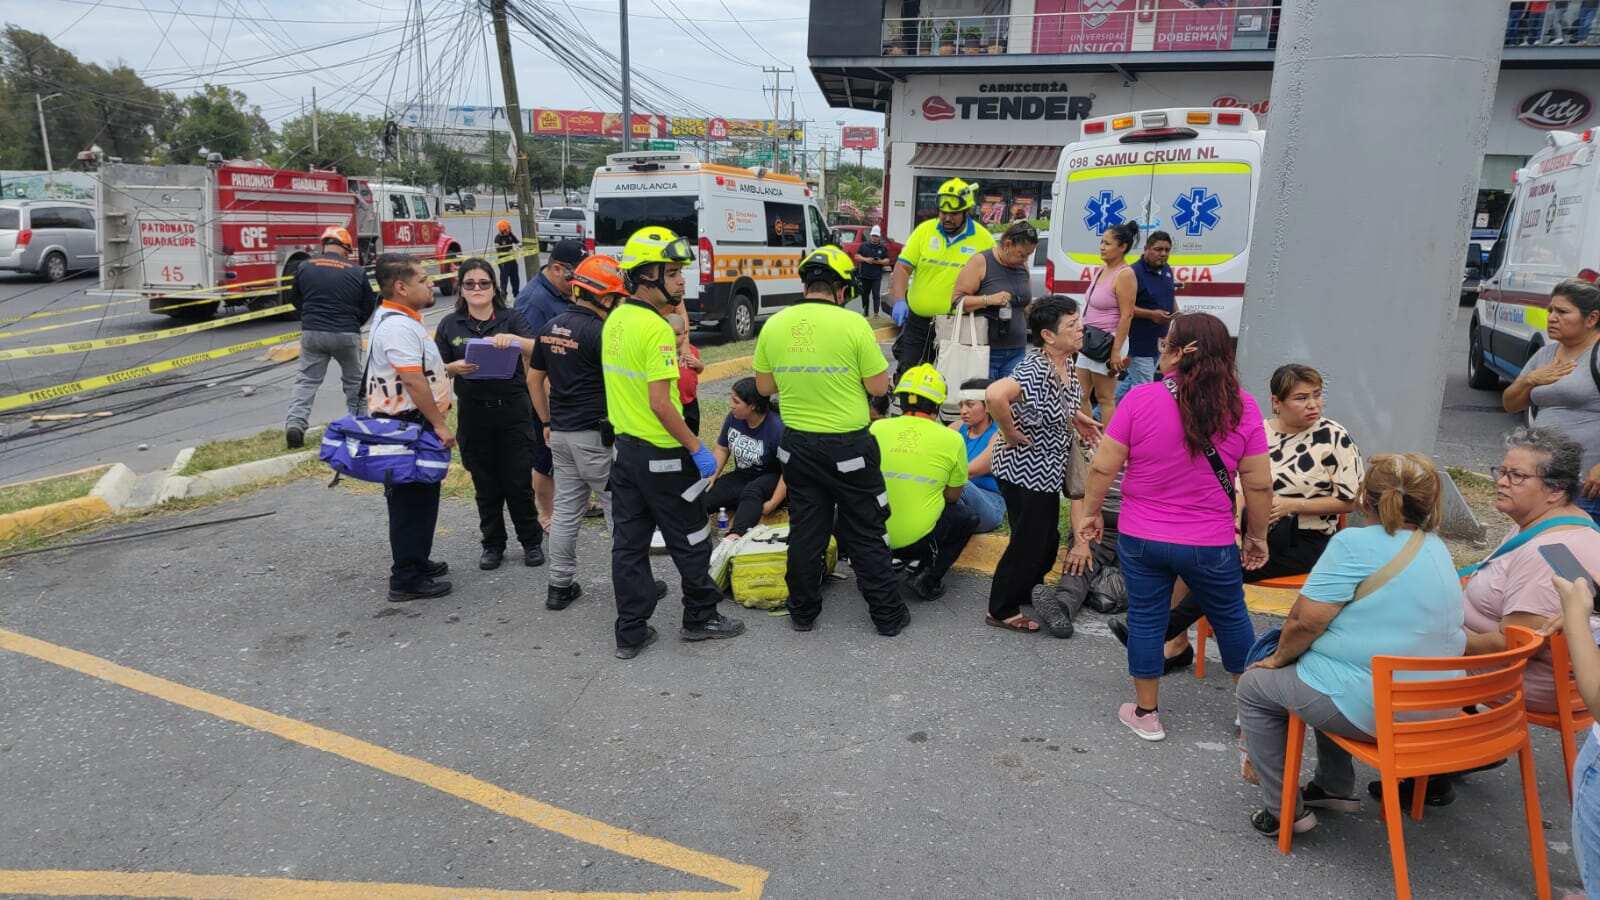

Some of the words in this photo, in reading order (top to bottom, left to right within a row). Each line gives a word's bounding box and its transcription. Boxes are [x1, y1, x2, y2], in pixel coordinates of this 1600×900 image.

[1158, 31, 1228, 42] DOBERMAN
[955, 96, 1093, 120] TENDER
[1517, 91, 1585, 126] Lety
[1069, 156, 1089, 168] 098
[1095, 151, 1138, 166] SAMU
[1143, 148, 1192, 163] CRUM
[1197, 146, 1219, 159] NL
[231, 173, 274, 188] PATRONATO
[291, 177, 329, 192] GUADALUPE
[614, 182, 678, 191] AMBULANCIA
[740, 183, 783, 196] AMBULANCIA
[141, 223, 195, 233] PATRONATO
[398, 225, 411, 242] 45
[143, 236, 196, 247] GUADALUPE
[240, 226, 268, 248] GPE
[161, 265, 184, 282] 45
[28, 383, 83, 401] PRECAUCION
[106, 367, 152, 384] PRECAUCION
